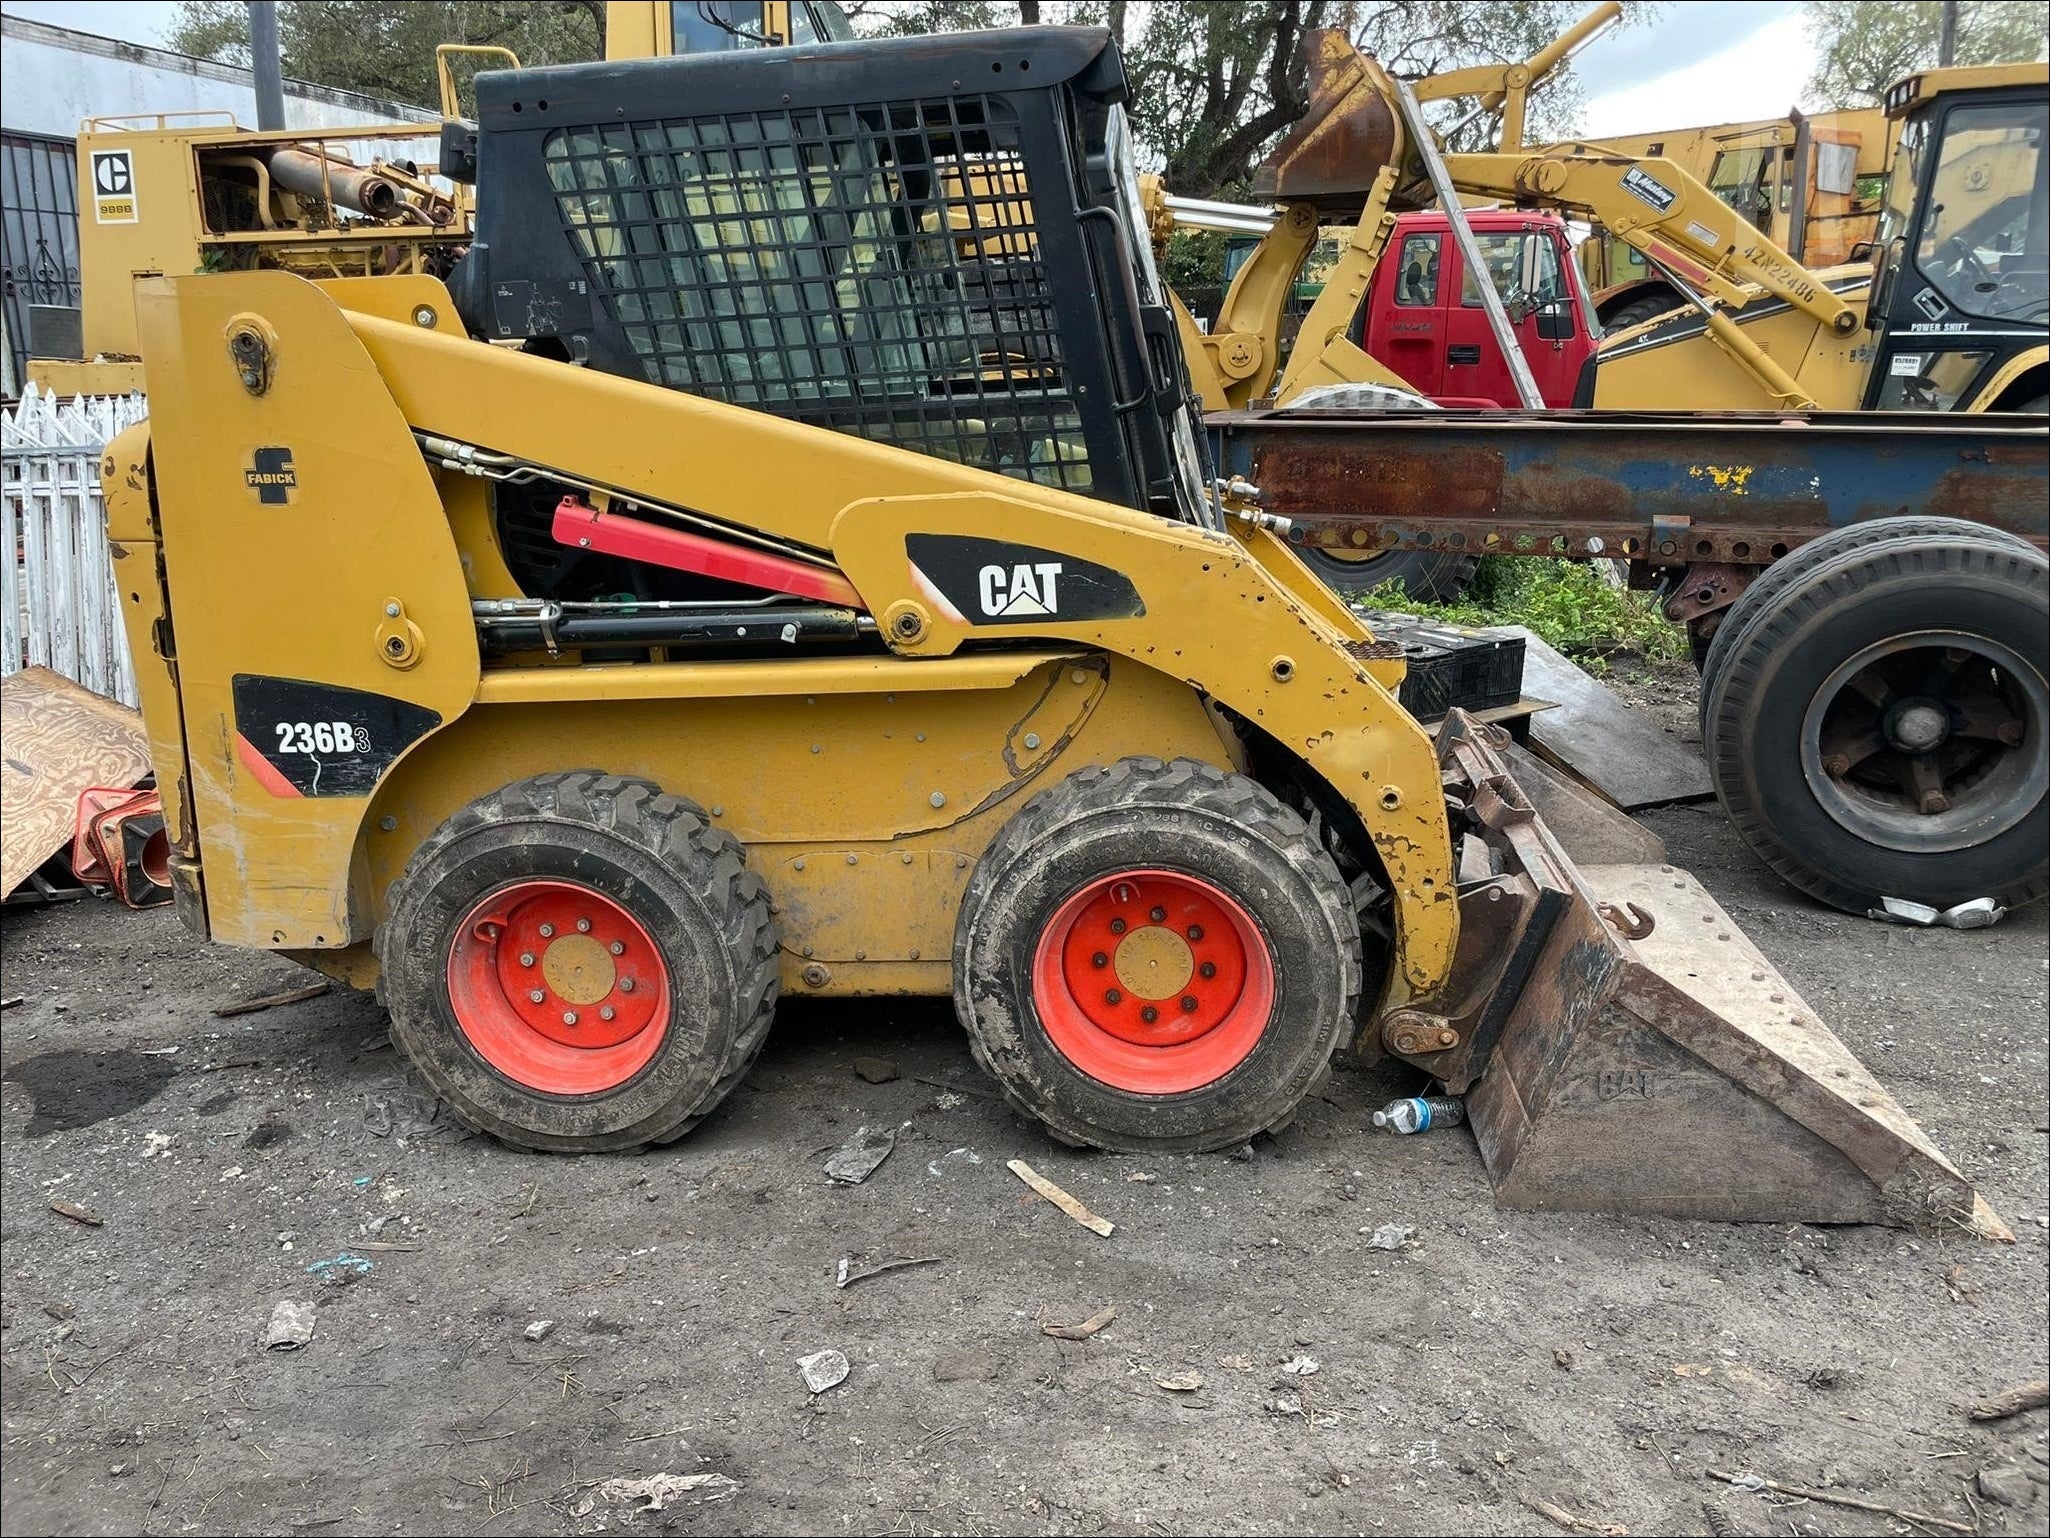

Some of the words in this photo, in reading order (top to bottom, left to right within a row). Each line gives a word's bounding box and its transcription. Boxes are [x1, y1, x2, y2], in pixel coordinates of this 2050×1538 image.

[1911, 323, 1941, 332] POWER
[1943, 322, 1969, 332] SHIFT
[247, 473, 295, 484] FABICK
[979, 563, 1062, 616] CAT
[276, 722, 371, 753] 236B3
